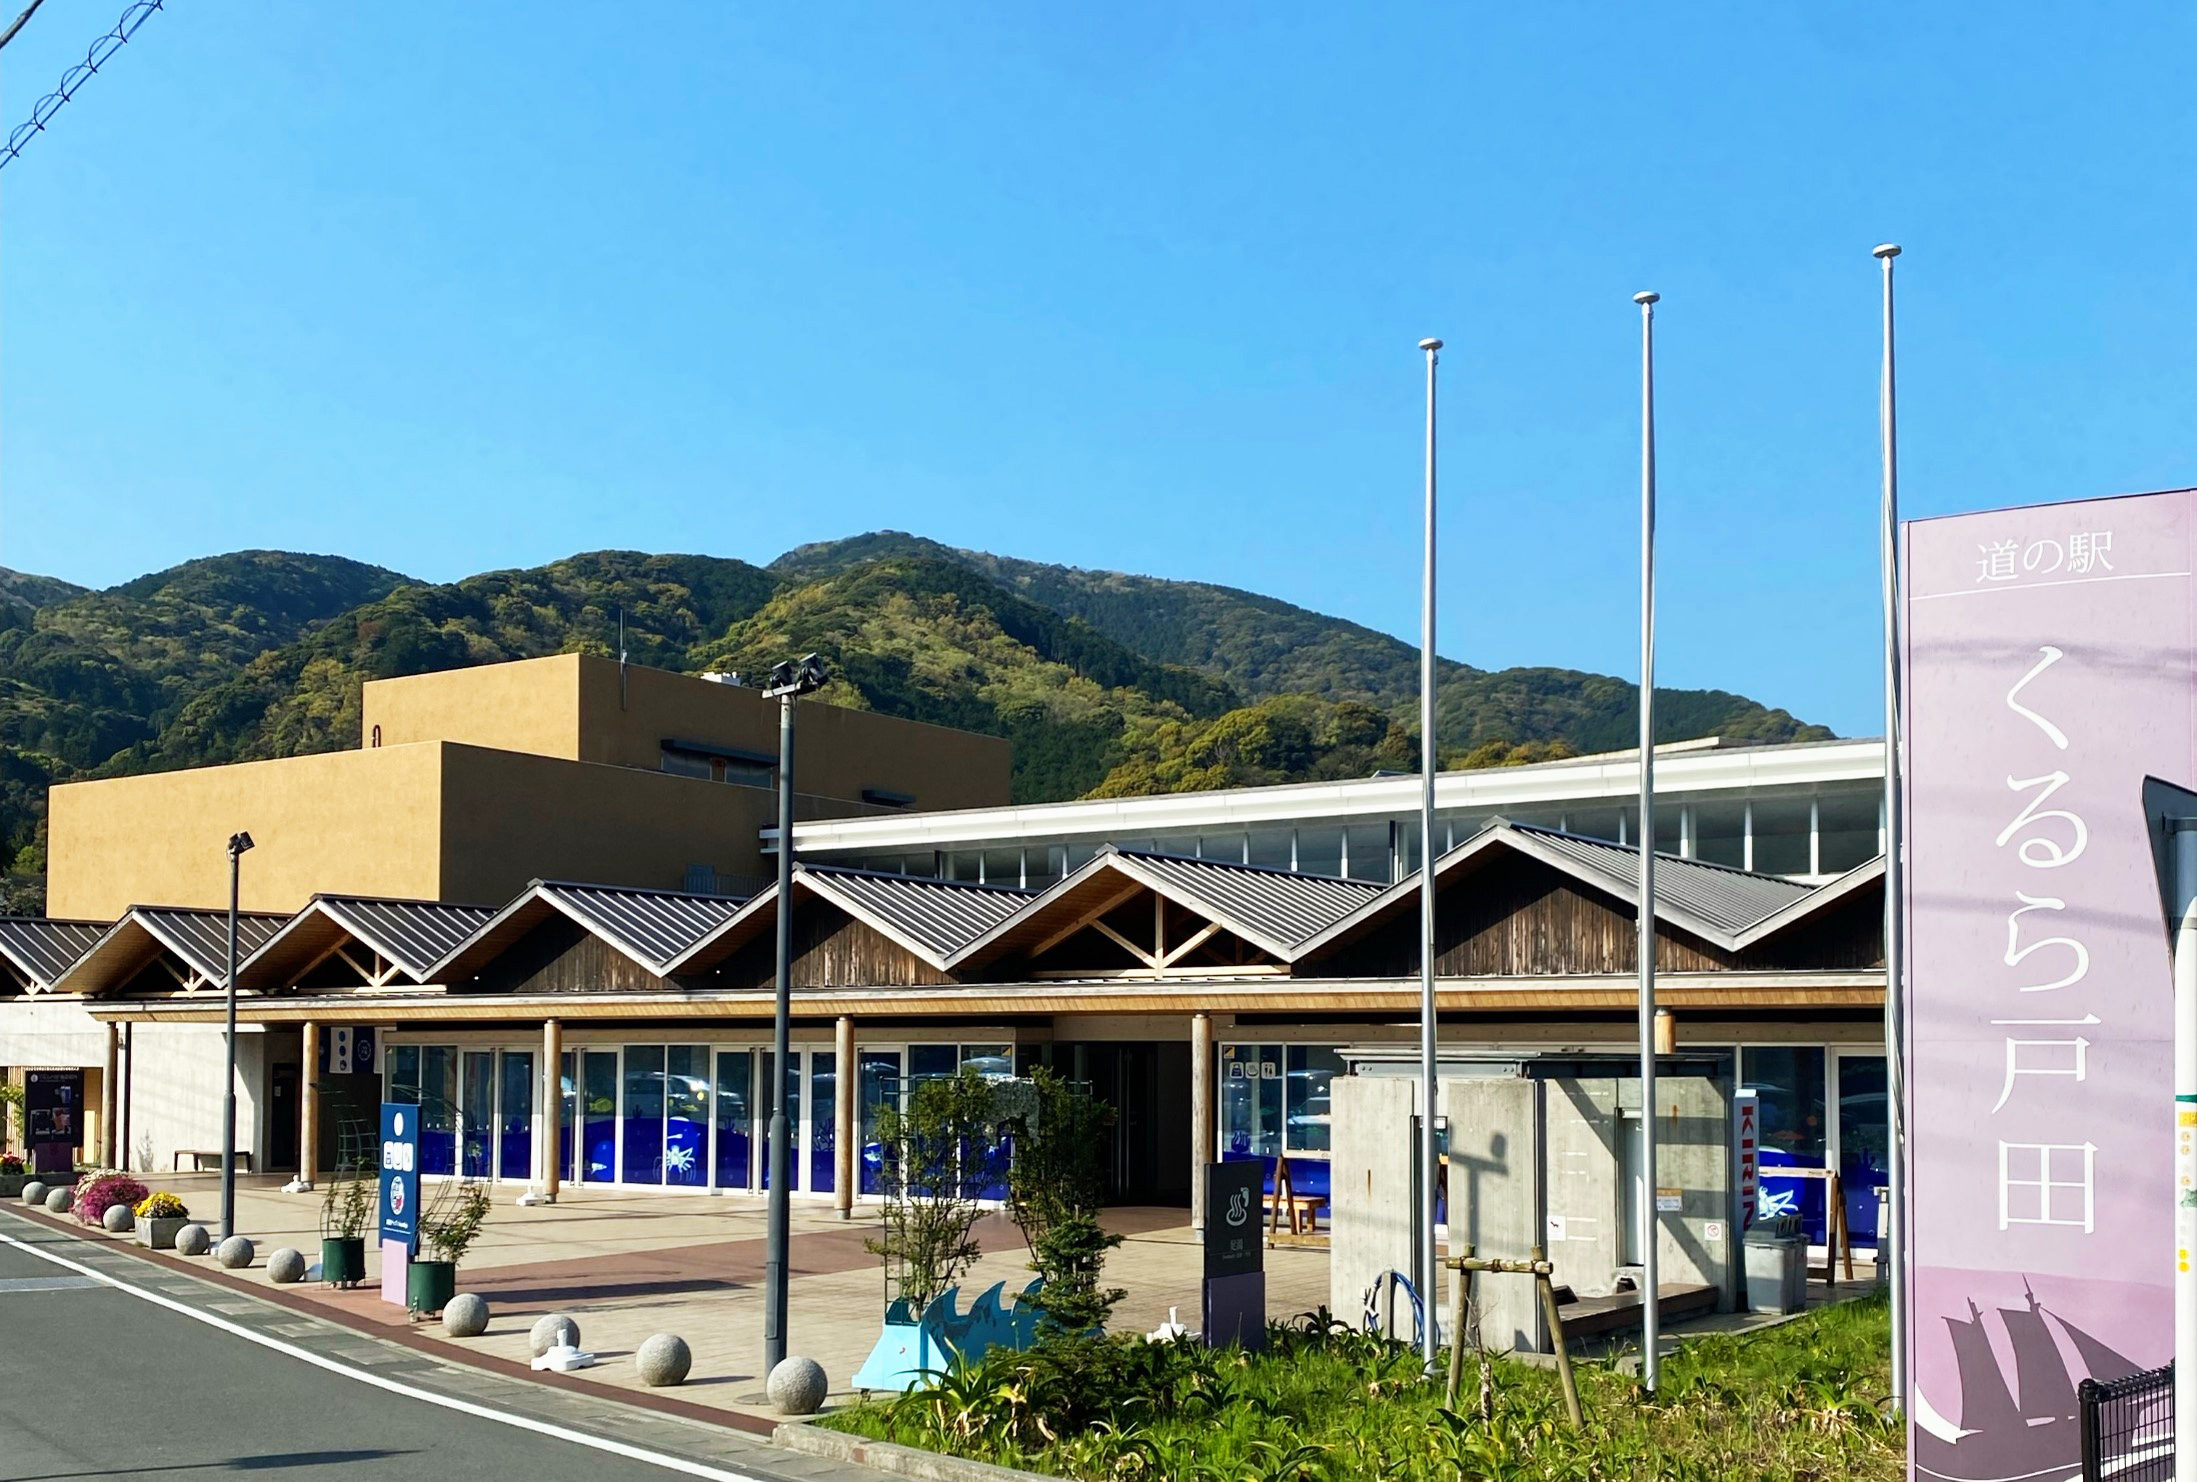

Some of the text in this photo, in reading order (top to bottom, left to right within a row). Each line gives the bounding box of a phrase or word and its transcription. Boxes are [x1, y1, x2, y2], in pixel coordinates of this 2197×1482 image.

[1975, 530, 2115, 584] 道の駅
[1990, 645, 2102, 1235] くるら戸田
[1741, 1105, 1755, 1232] KIRIN
